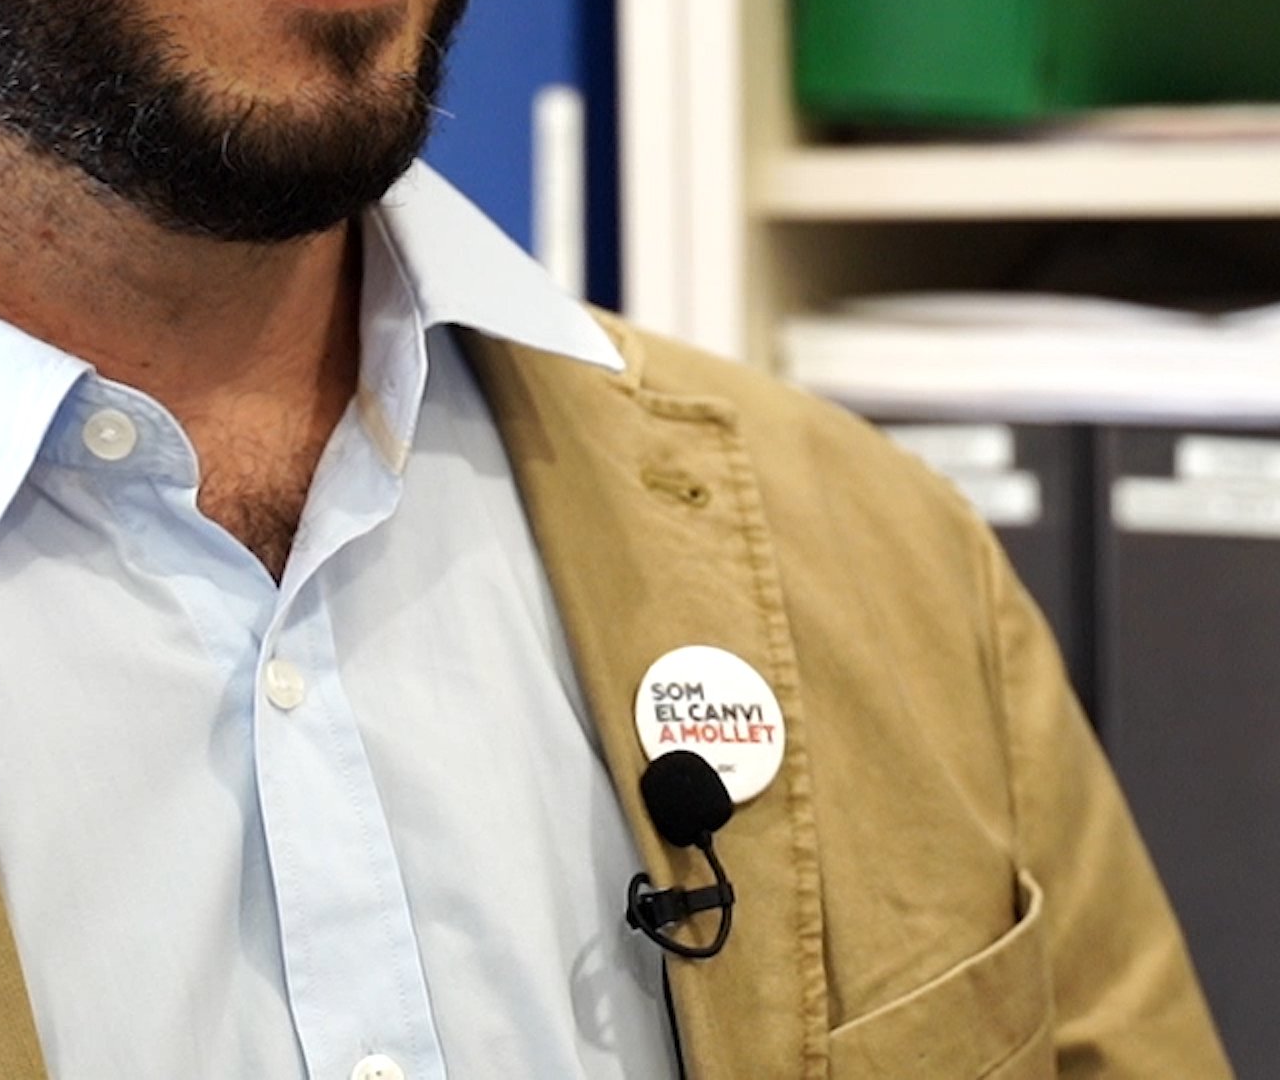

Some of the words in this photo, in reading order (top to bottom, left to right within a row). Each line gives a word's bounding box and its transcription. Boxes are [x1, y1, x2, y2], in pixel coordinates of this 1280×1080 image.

[651, 682, 705, 701] SOM
[655, 704, 684, 722] EL
[688, 704, 763, 722] CANVI
[660, 725, 676, 743] A
[680, 725, 775, 743] MOLLET
